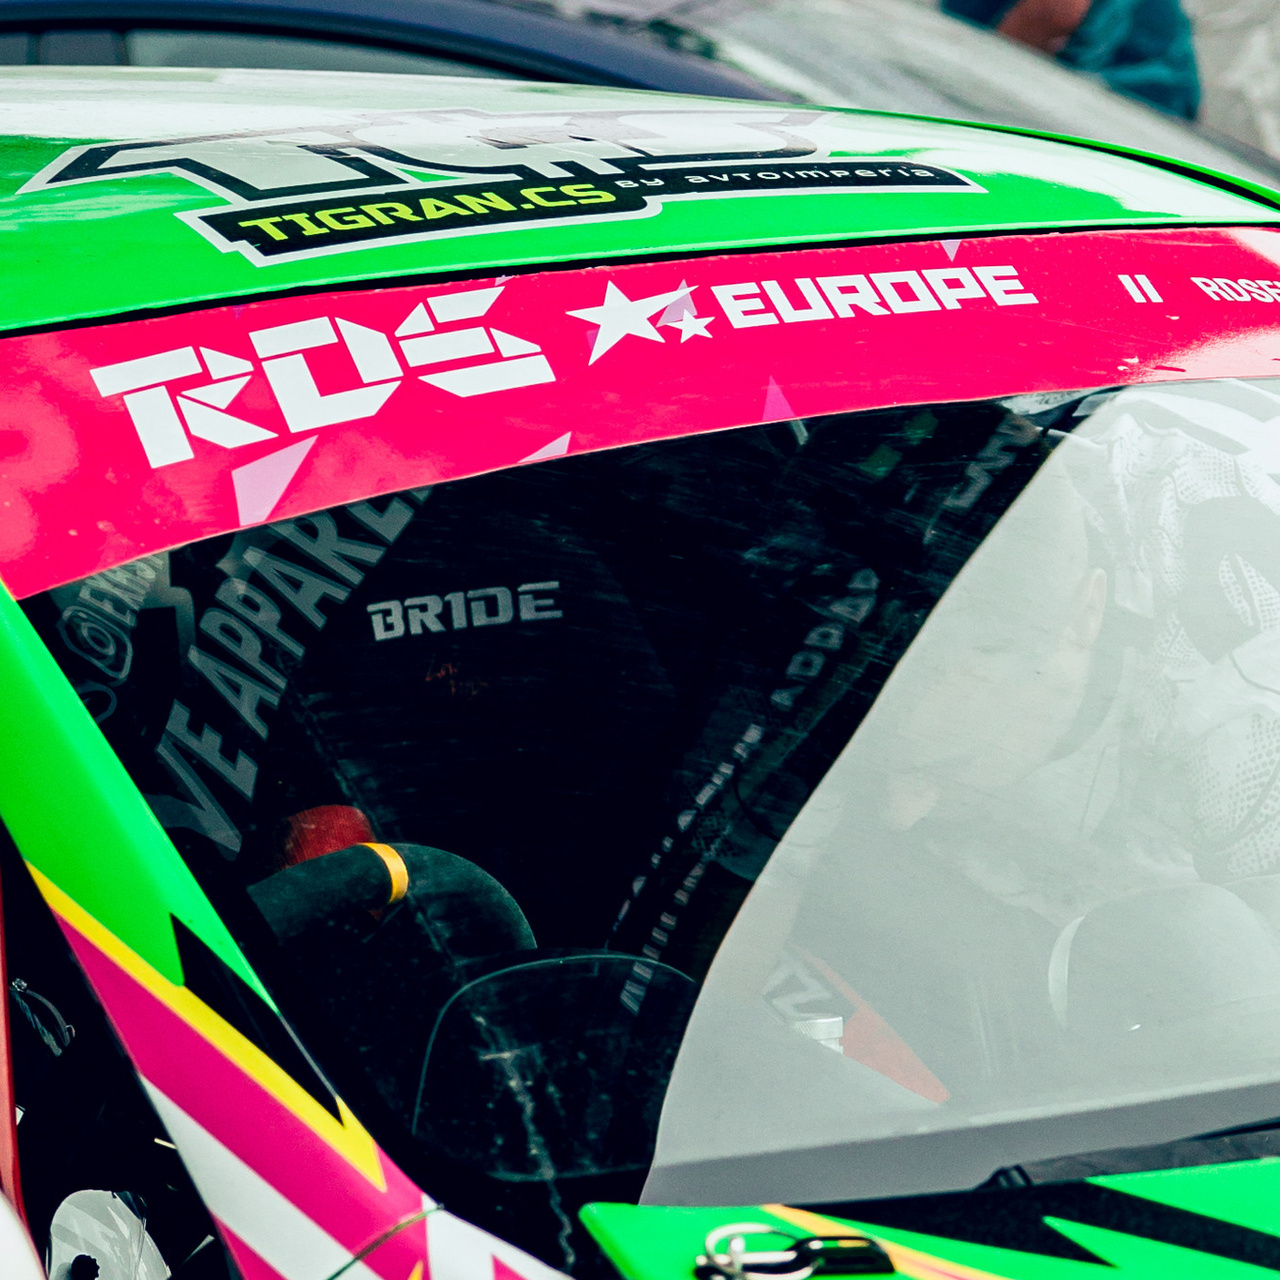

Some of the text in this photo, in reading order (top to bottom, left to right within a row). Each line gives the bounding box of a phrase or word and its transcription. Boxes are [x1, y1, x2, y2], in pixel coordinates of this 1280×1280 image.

[238, 182, 616, 242] TIGRAN.CS
[89, 286, 556, 469] RDS
[711, 265, 1039, 330] EUROPE
